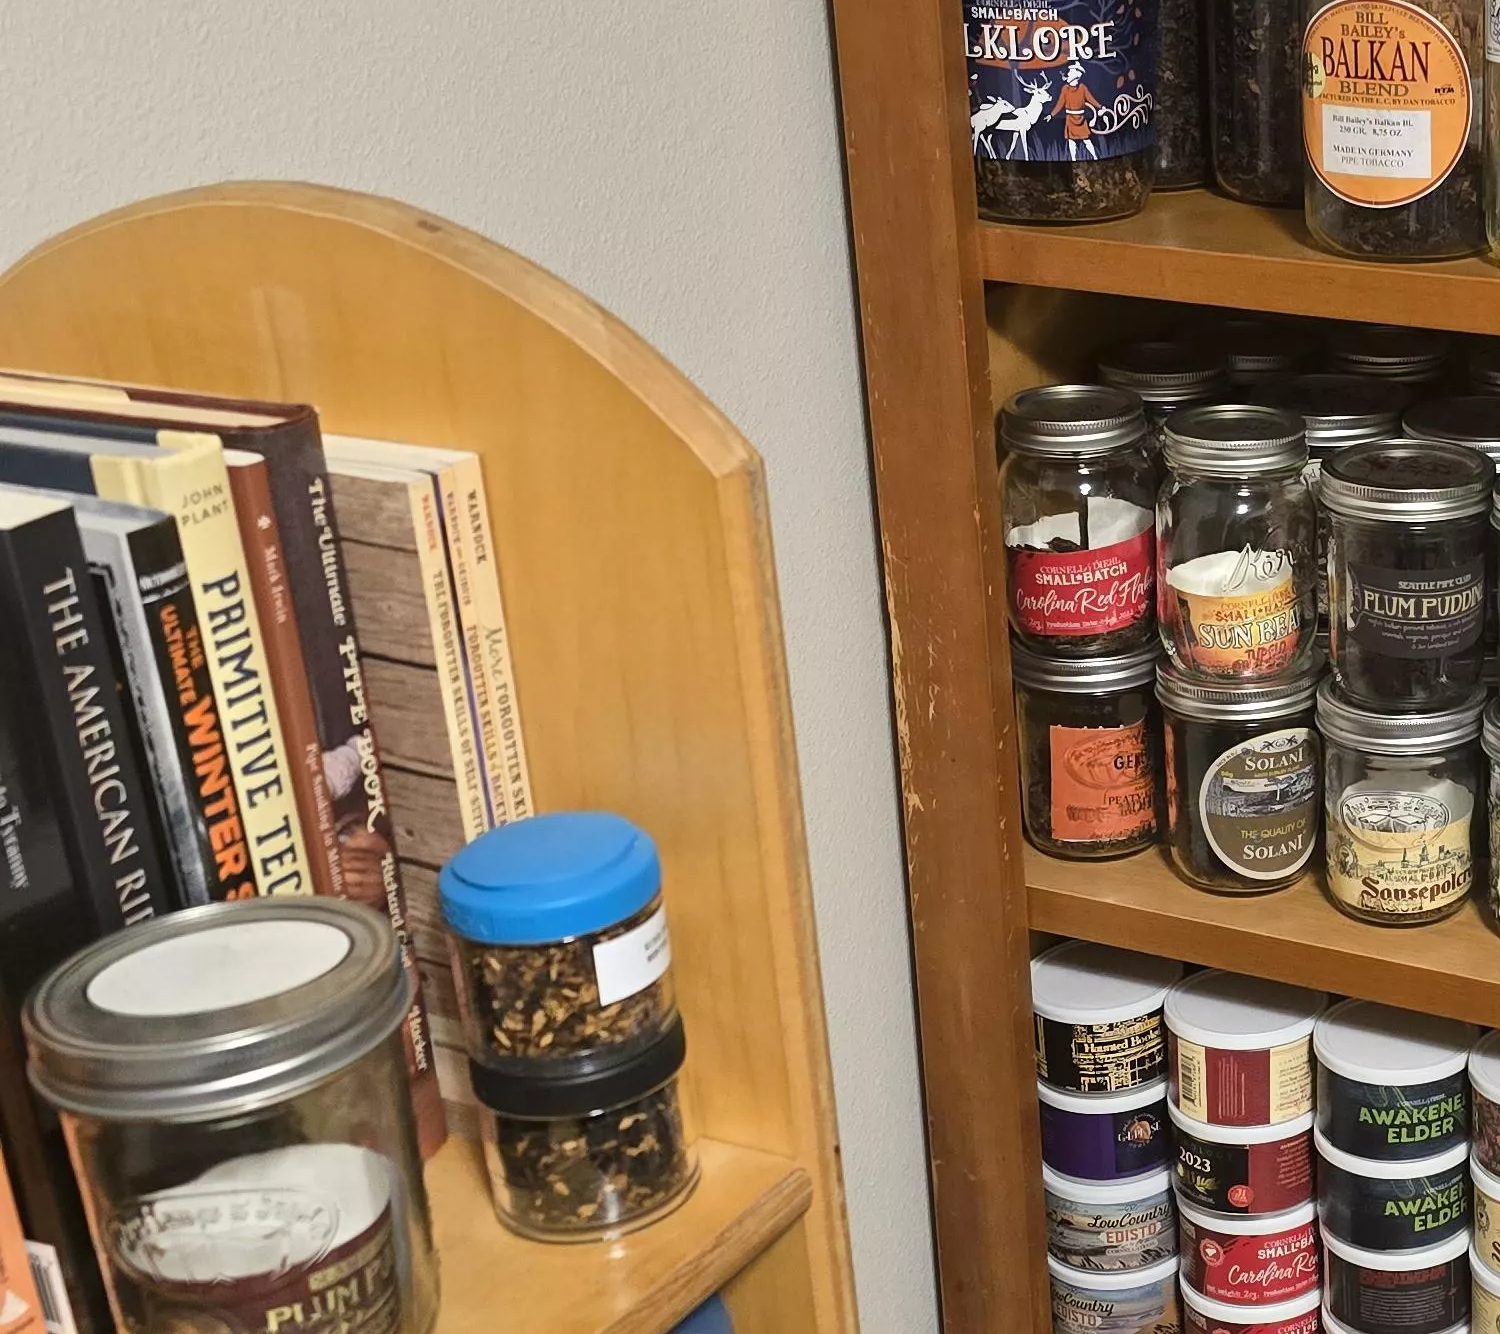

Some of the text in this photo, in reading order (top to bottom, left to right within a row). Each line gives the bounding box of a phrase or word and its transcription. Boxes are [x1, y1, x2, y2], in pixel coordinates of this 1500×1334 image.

[971, 7, 1058, 21] SMALL BATCH
[1356, 12, 1388, 24] BILL
[1341, 24, 1405, 39] BAILEY's
[1321, 36, 1431, 83] BALKAN
[1340, 81, 1409, 97] BLEND
[1333, 145, 1414, 157] MADE GERMANY
[1361, 159, 1404, 167] TOBACCO
[180, 483, 225, 508] JOHN
[180, 500, 230, 528] PLANT
[1035, 563, 1127, 586] SMALL BATCH
[1040, 565, 1087, 574] CORNELL
[1398, 580, 1435, 590] SEATTLE
[1016, 581, 1119, 617] Carolina Red
[1363, 582, 1483, 619] PLUM PUDDIN
[185, 623, 205, 670] THE
[467, 489, 488, 565] WARNOCK
[495, 682, 524, 789] FORGOTTEN
[1199, 622, 1255, 649] SUN
[160, 604, 198, 705] ULTIMATE
[307, 477, 388, 833] The Ultimate PIPE BOOK
[201, 569, 284, 809] PRIMITIVE
[43, 568, 141, 872] THE AMERICAN
[1244, 747, 1303, 771] SOLANI
[184, 693, 250, 883] WINTER
[1260, 824, 1295, 838] QUALITY
[1243, 835, 1303, 860] SOLANI
[1361, 863, 1472, 903] Sansepolcr
[1084, 1038, 1129, 1054] Haunted
[1359, 1093, 1465, 1126] AWAKENE
[1387, 1118, 1454, 1144] ELDER
[1179, 1147, 1211, 1173] 2023
[1088, 1203, 1170, 1229] LowCountry
[1414, 1200, 1468, 1232] ELDER
[1106, 1222, 1158, 1244] EDISTO
[1257, 1242, 1297, 1260] SMALL
[1228, 1260, 1294, 1286] Carolina
[1056, 1305, 1097, 1327] EDISTO
